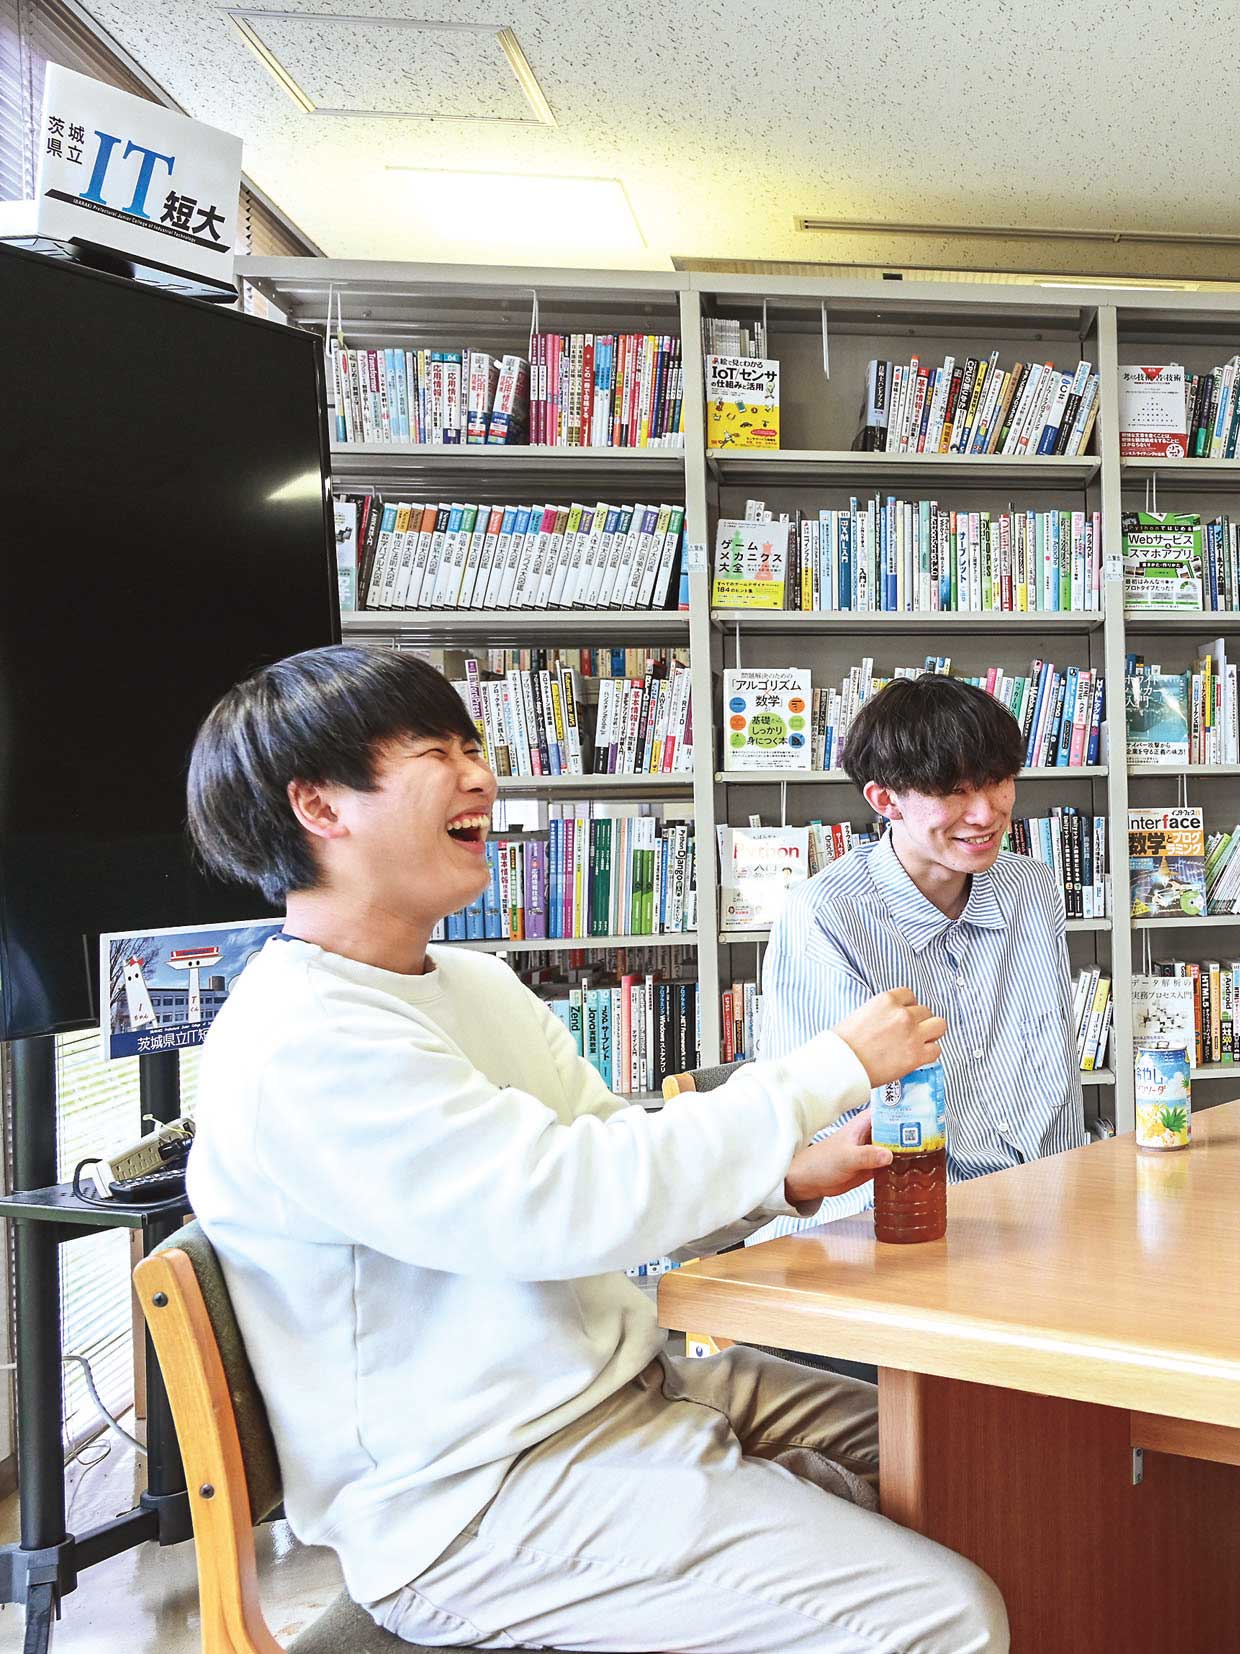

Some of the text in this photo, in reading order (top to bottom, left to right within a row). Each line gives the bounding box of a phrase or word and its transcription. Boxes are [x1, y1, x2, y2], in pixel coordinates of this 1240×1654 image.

[47, 116, 85, 145] 茨城
[47, 138, 83, 165] 県立
[79, 130, 176, 220] IT
[160, 190, 226, 242] 短大
[720, 357, 763, 368] 絵で見てわかる
[711, 380, 764, 391] の仕組みと活用
[721, 540, 758, 551] ゲーム
[1128, 535, 1193, 545] Webサービス
[719, 552, 783, 563] メカニクス
[959, 531, 968, 583] サーブレット
[1129, 549, 1192, 560] スマホアプリ
[718, 562, 744, 573] 大全
[752, 726, 782, 735] しっかり
[747, 737, 788, 745] 身につく本
[1128, 832, 1166, 855] 数学
[675, 850, 686, 881] Django
[1132, 992, 1193, 1000] 実務プロセス入門
[571, 1006, 581, 1031] Zend
